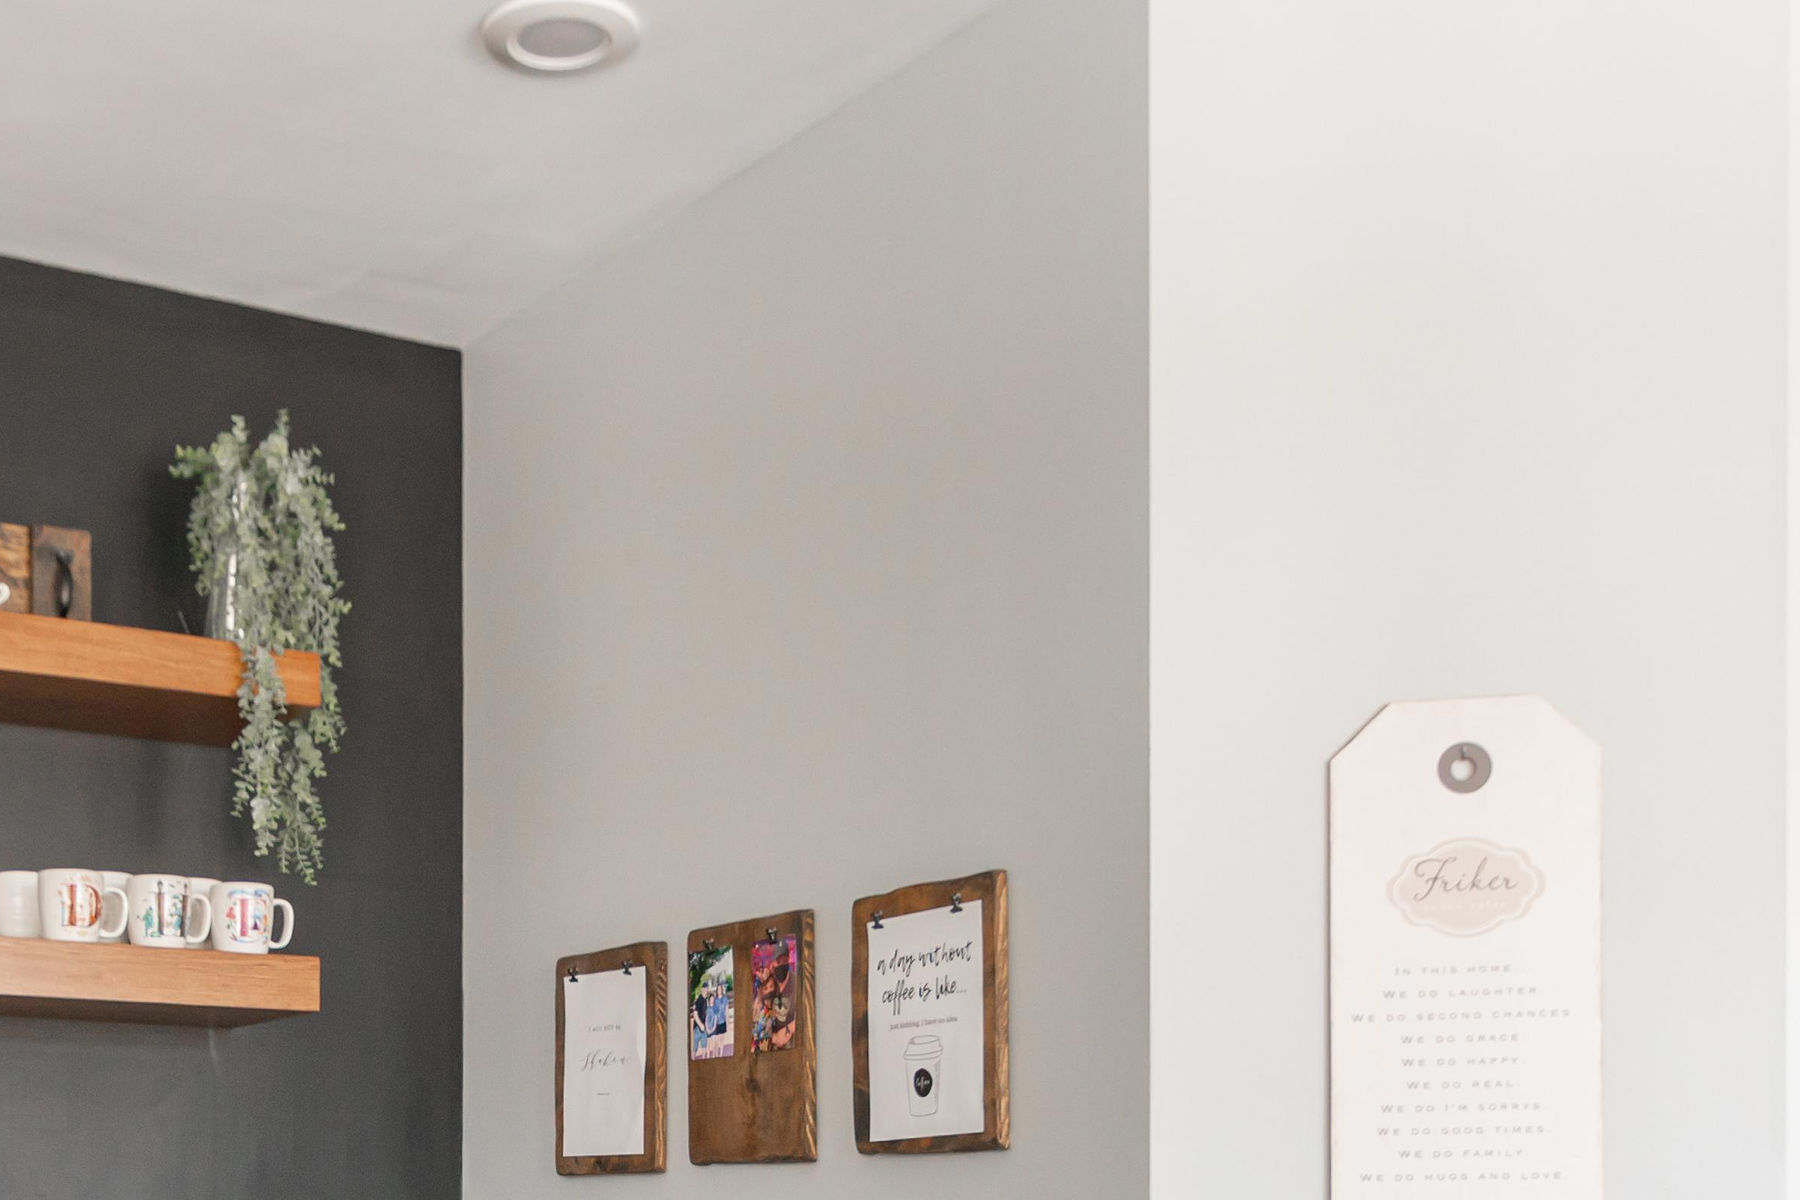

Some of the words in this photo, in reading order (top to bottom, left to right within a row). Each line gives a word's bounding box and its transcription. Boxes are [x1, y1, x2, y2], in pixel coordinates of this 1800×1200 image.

[1412, 855, 1518, 902] Friker
[876, 959, 887, 976] a
[889, 949, 916, 977] day
[918, 941, 973, 967] without
[1394, 967, 1412, 976] IN
[1421, 966, 1458, 975] THIS
[882, 979, 915, 1016] coffee
[918, 982, 932, 1002] is
[1382, 990, 1407, 999] WE
[1418, 990, 1438, 998] DO
[1351, 1013, 1375, 1023] WE
[1385, 1014, 1407, 1022] DO
[1416, 1011, 1483, 1021] SECOND
[1400, 1035, 1425, 1044] WE
[1436, 1035, 1456, 1043] DO
[1401, 1058, 1426, 1067] WE
[1436, 1058, 1457, 1066] DO
[1406, 1081, 1431, 1090] WE
[1441, 1081, 1462, 1089] DO
[1380, 1104, 1405, 1113] WE
[1415, 1104, 1435, 1112] DO
[1376, 1127, 1400, 1136] WE
[1411, 1127, 1431, 1136] DO
[1441, 1126, 1485, 1135] GOOD
[1398, 1150, 1423, 1159] WE
[1432, 1150, 1453, 1158] DO
[1360, 1173, 1384, 1182] WE
[1394, 1173, 1415, 1181] DO
[1424, 1172, 1469, 1181] HUGS
[1478, 1172, 1511, 1180] AND
